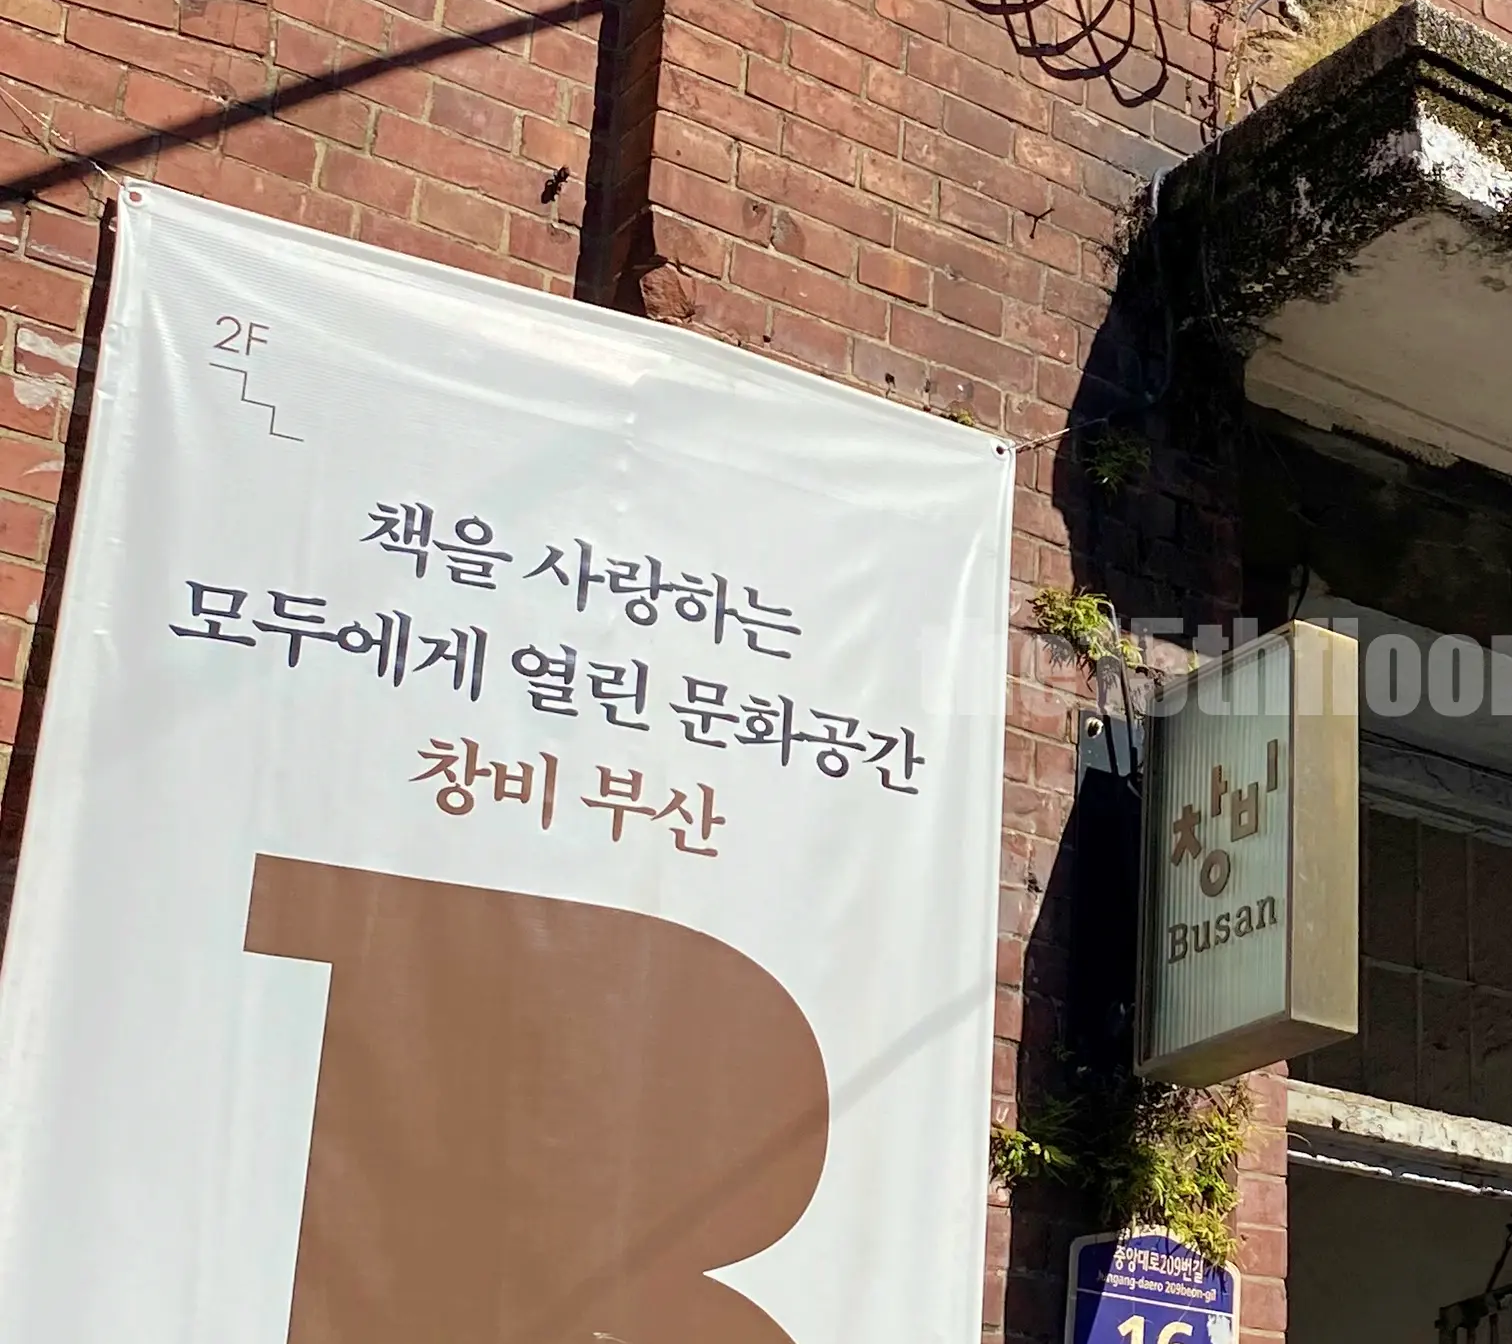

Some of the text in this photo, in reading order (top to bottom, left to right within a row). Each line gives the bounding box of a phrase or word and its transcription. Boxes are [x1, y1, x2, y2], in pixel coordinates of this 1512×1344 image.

[213, 315, 270, 357] 2F
[359, 502, 802, 660] 책을 사랑하는
[168, 580, 926, 795] 모두에게 열린 문화공간
[408, 736, 727, 858] 창비 부산
[1170, 738, 1280, 898] 창비
[1167, 895, 1279, 964] Busan
[1113, 1245, 1204, 1284] 중앙대로209번길
[1164, 1281, 1217, 1303] 209beon-gil
